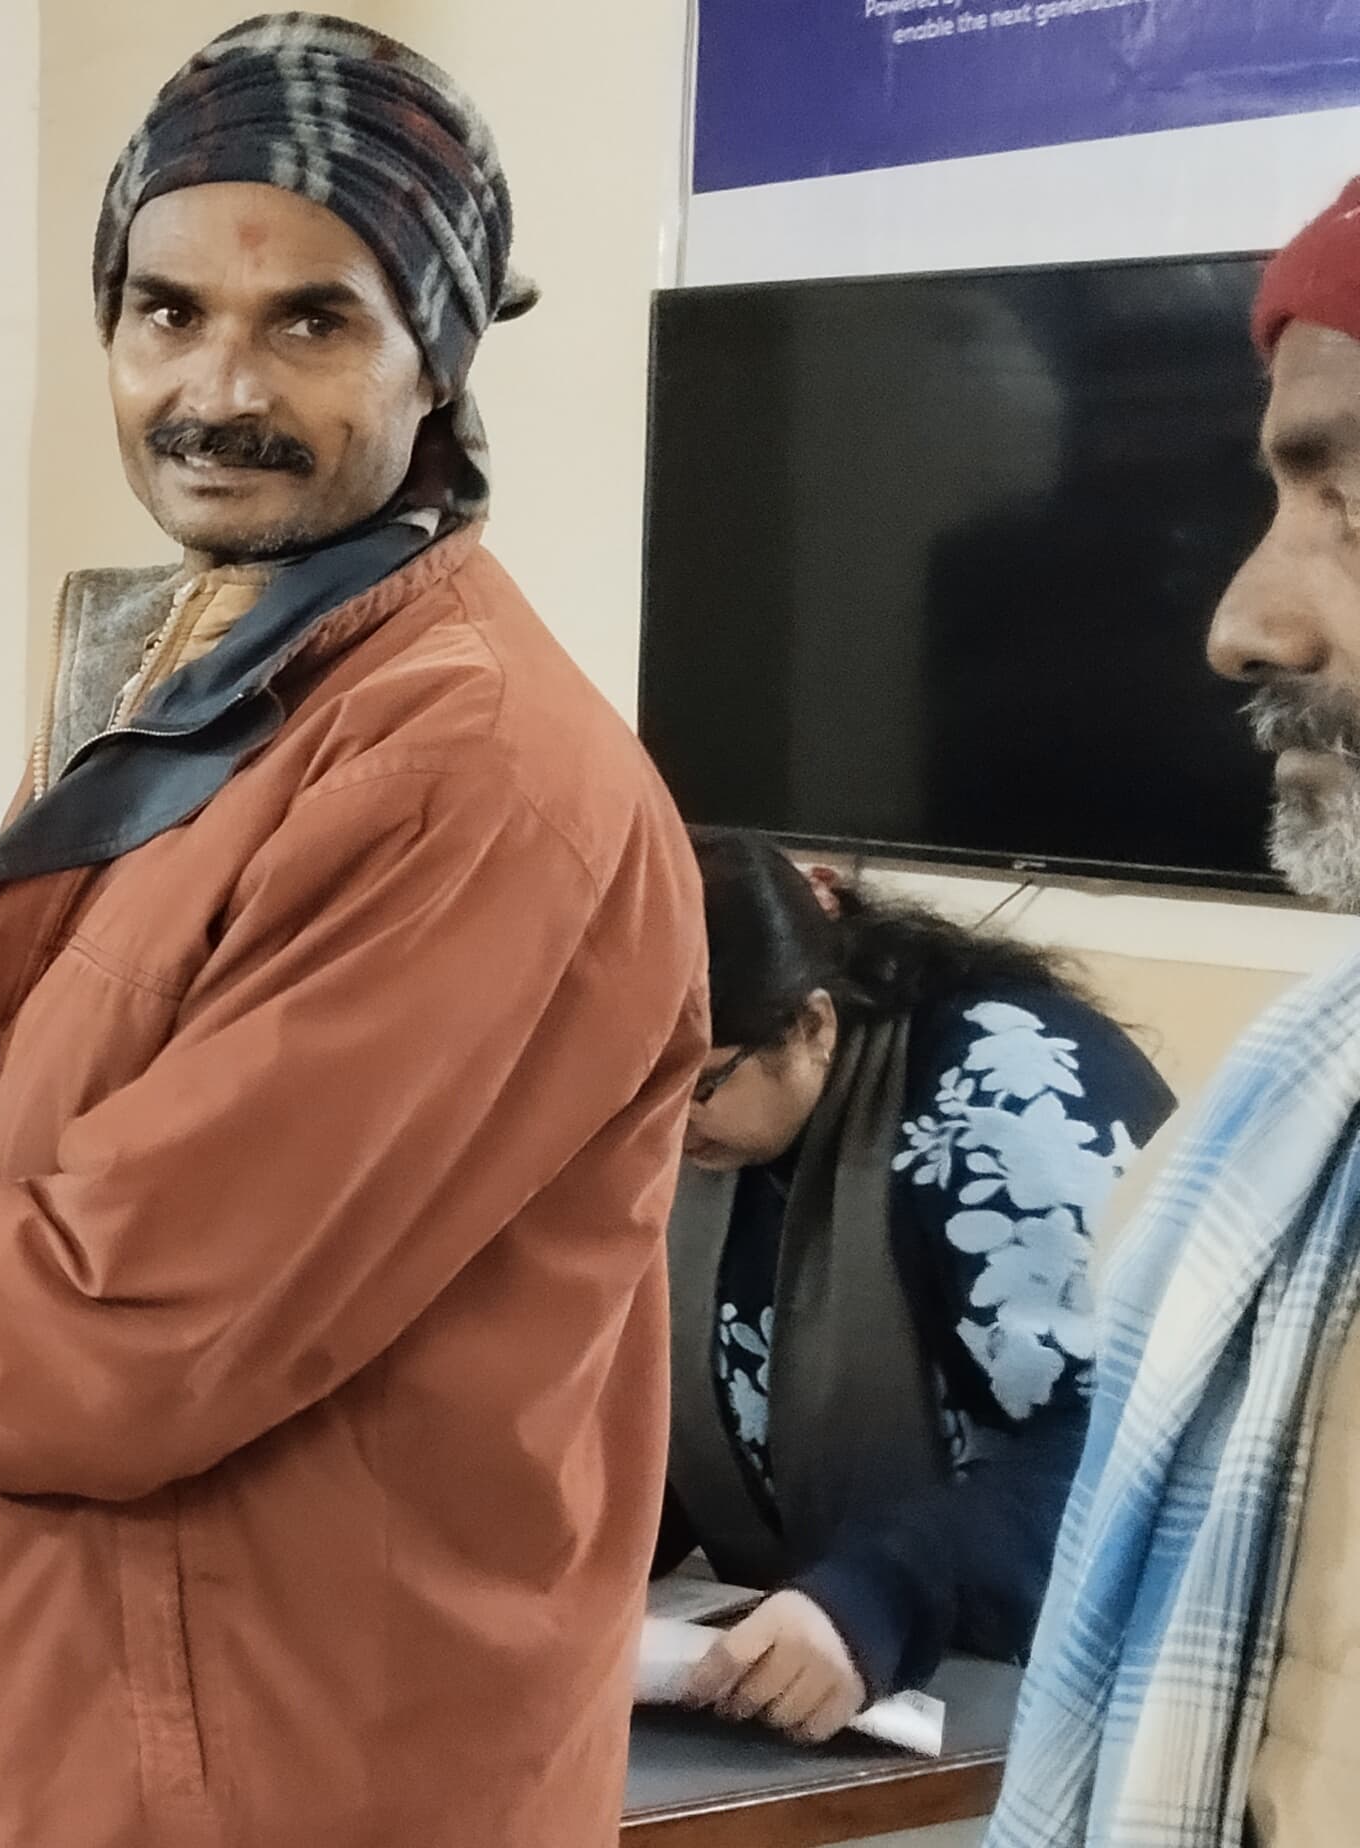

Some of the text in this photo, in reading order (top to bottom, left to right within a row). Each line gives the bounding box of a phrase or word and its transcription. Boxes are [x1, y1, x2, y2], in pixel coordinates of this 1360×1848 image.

[892, 17, 954, 44] enable
[956, 11, 988, 33] the
[990, 5, 1031, 28] next
